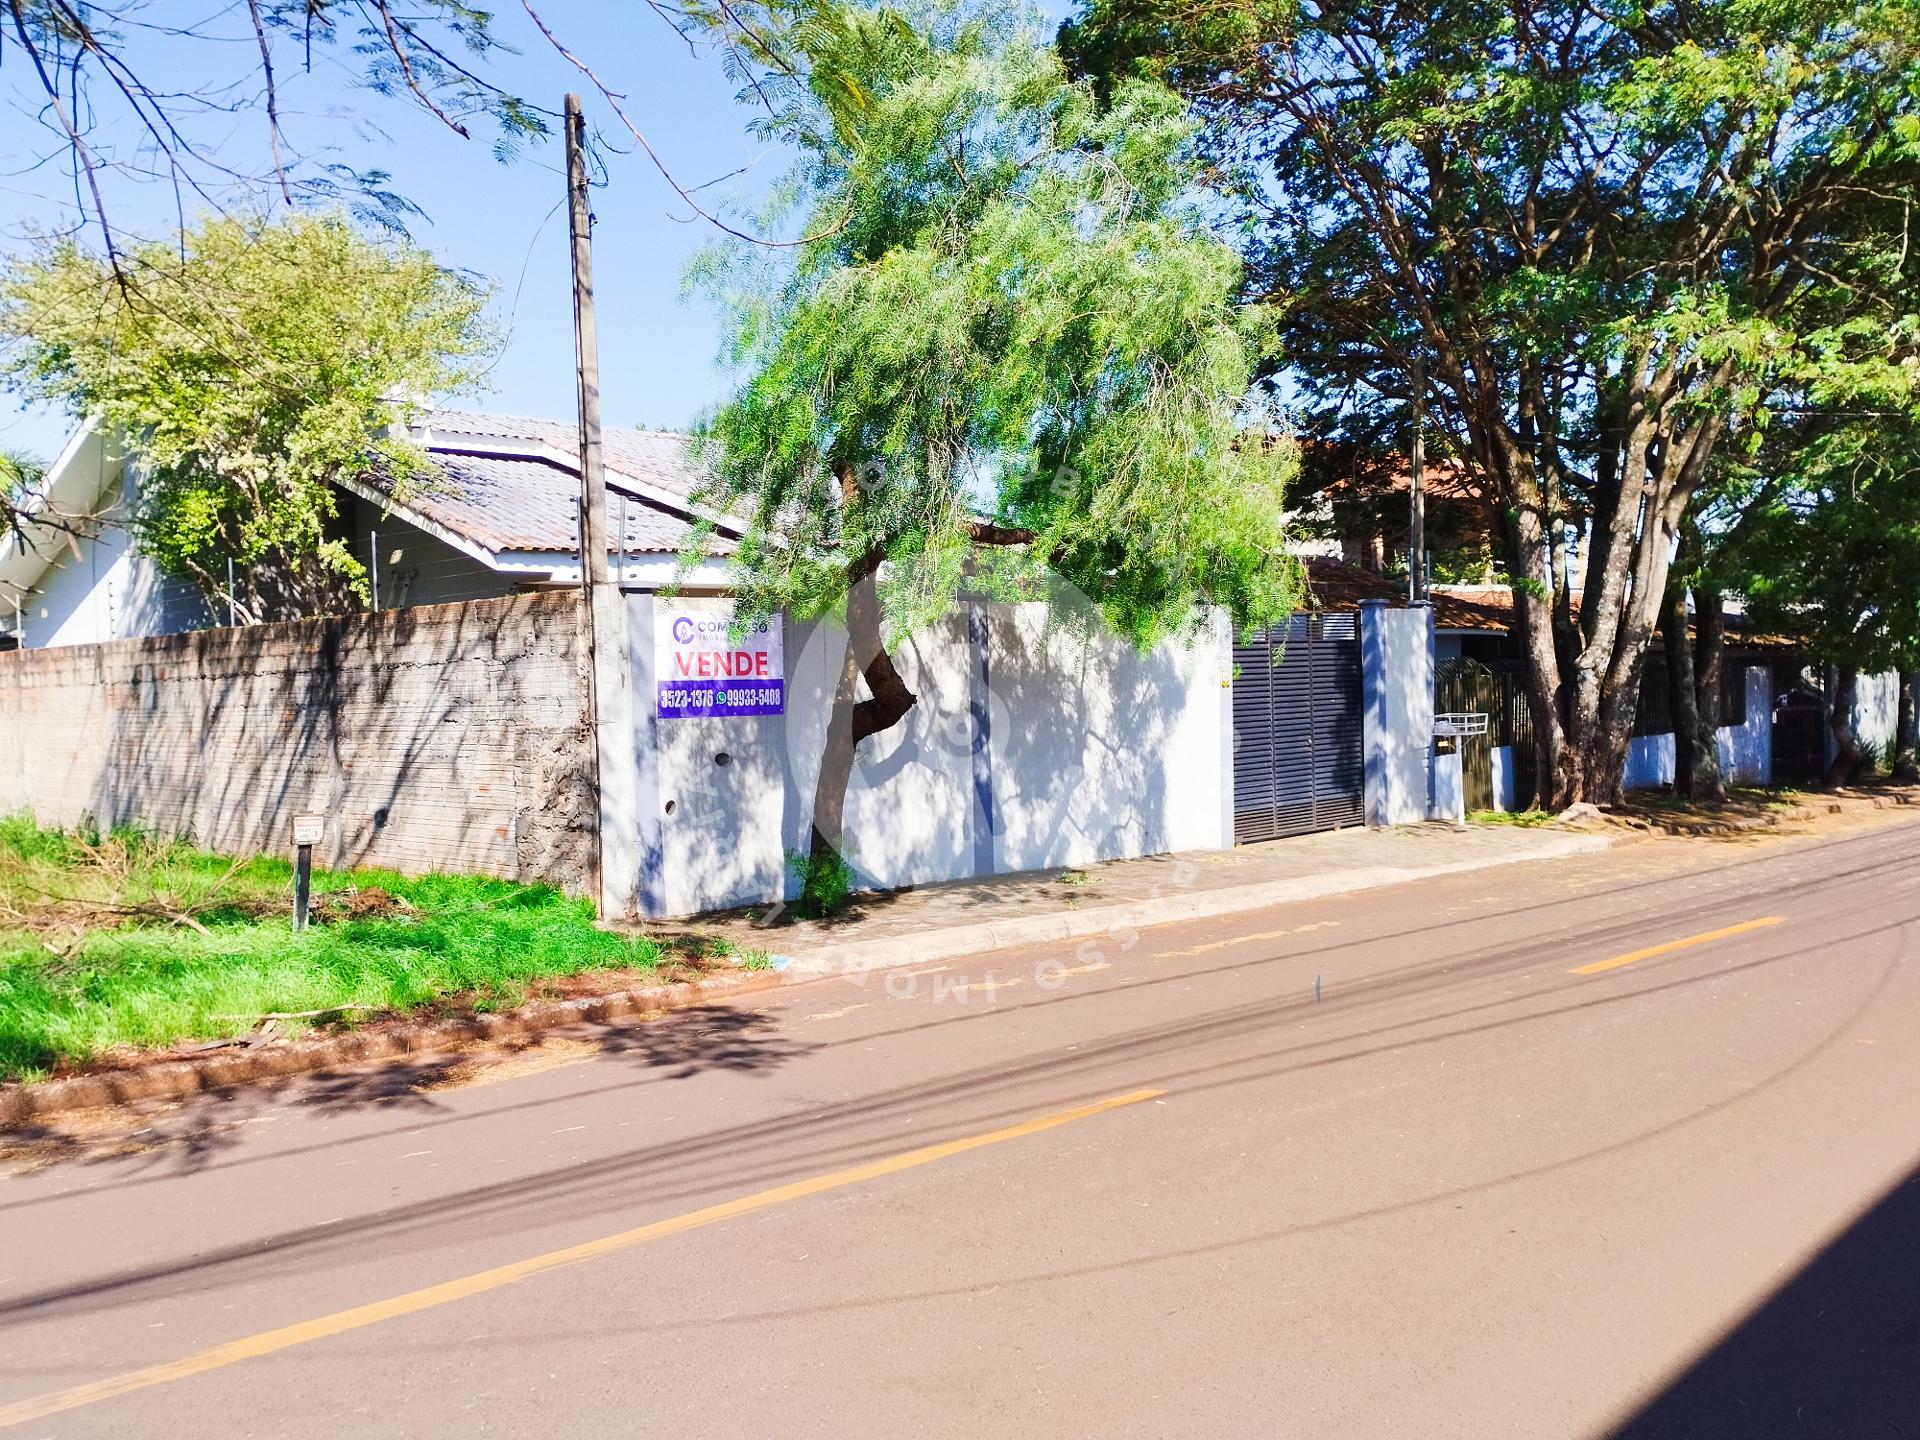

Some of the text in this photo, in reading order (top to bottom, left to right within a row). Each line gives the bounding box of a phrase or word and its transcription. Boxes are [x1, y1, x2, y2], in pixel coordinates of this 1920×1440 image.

[675, 652, 768, 676] VENDE
[661, 688, 780, 708] 3523-1376 99933-5408
